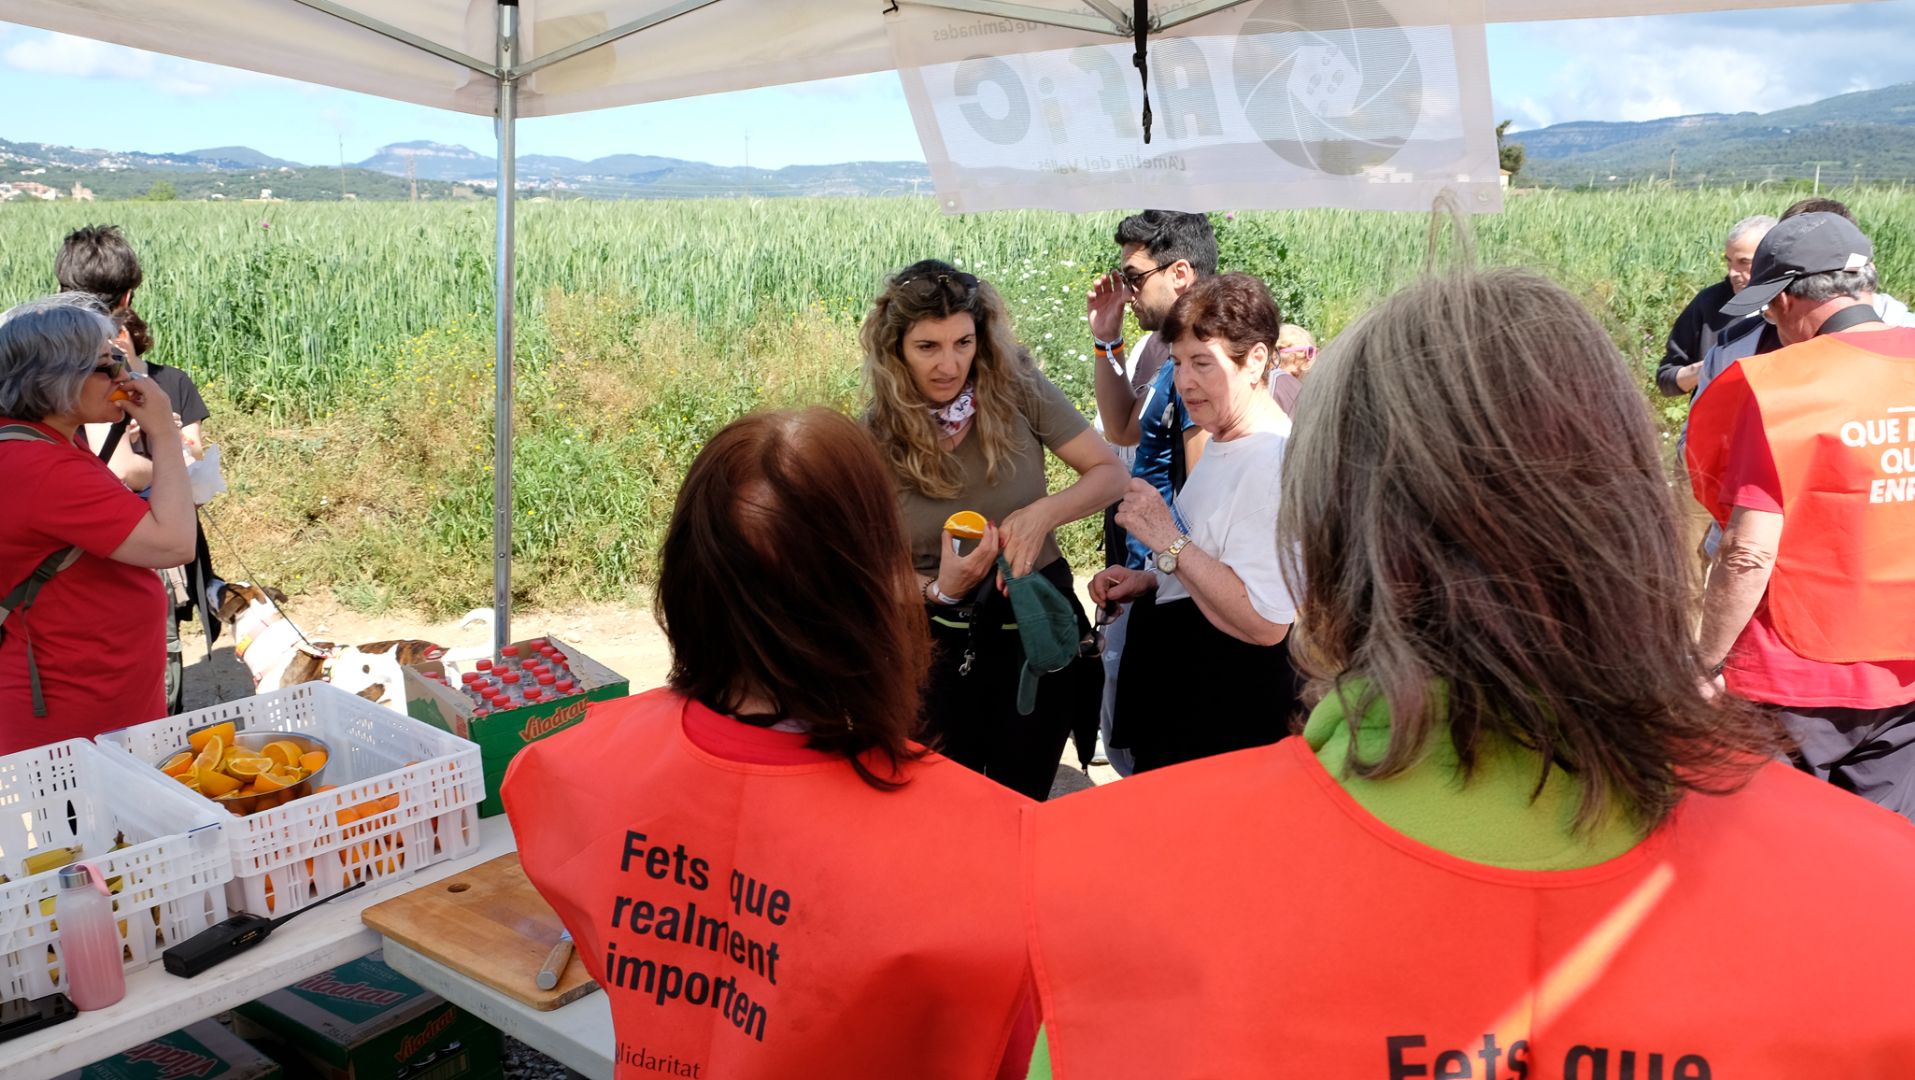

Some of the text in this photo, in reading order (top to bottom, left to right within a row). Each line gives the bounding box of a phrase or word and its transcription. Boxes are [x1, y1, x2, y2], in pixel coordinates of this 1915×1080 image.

[1841, 418, 1900, 447] QUE
[518, 696, 589, 742] Viladrau
[620, 830, 791, 926] Fets que
[611, 895, 800, 986] realment
[294, 970, 407, 1005] iladrau
[606, 942, 788, 1042] importen
[1386, 1033, 1530, 1080] Fets
